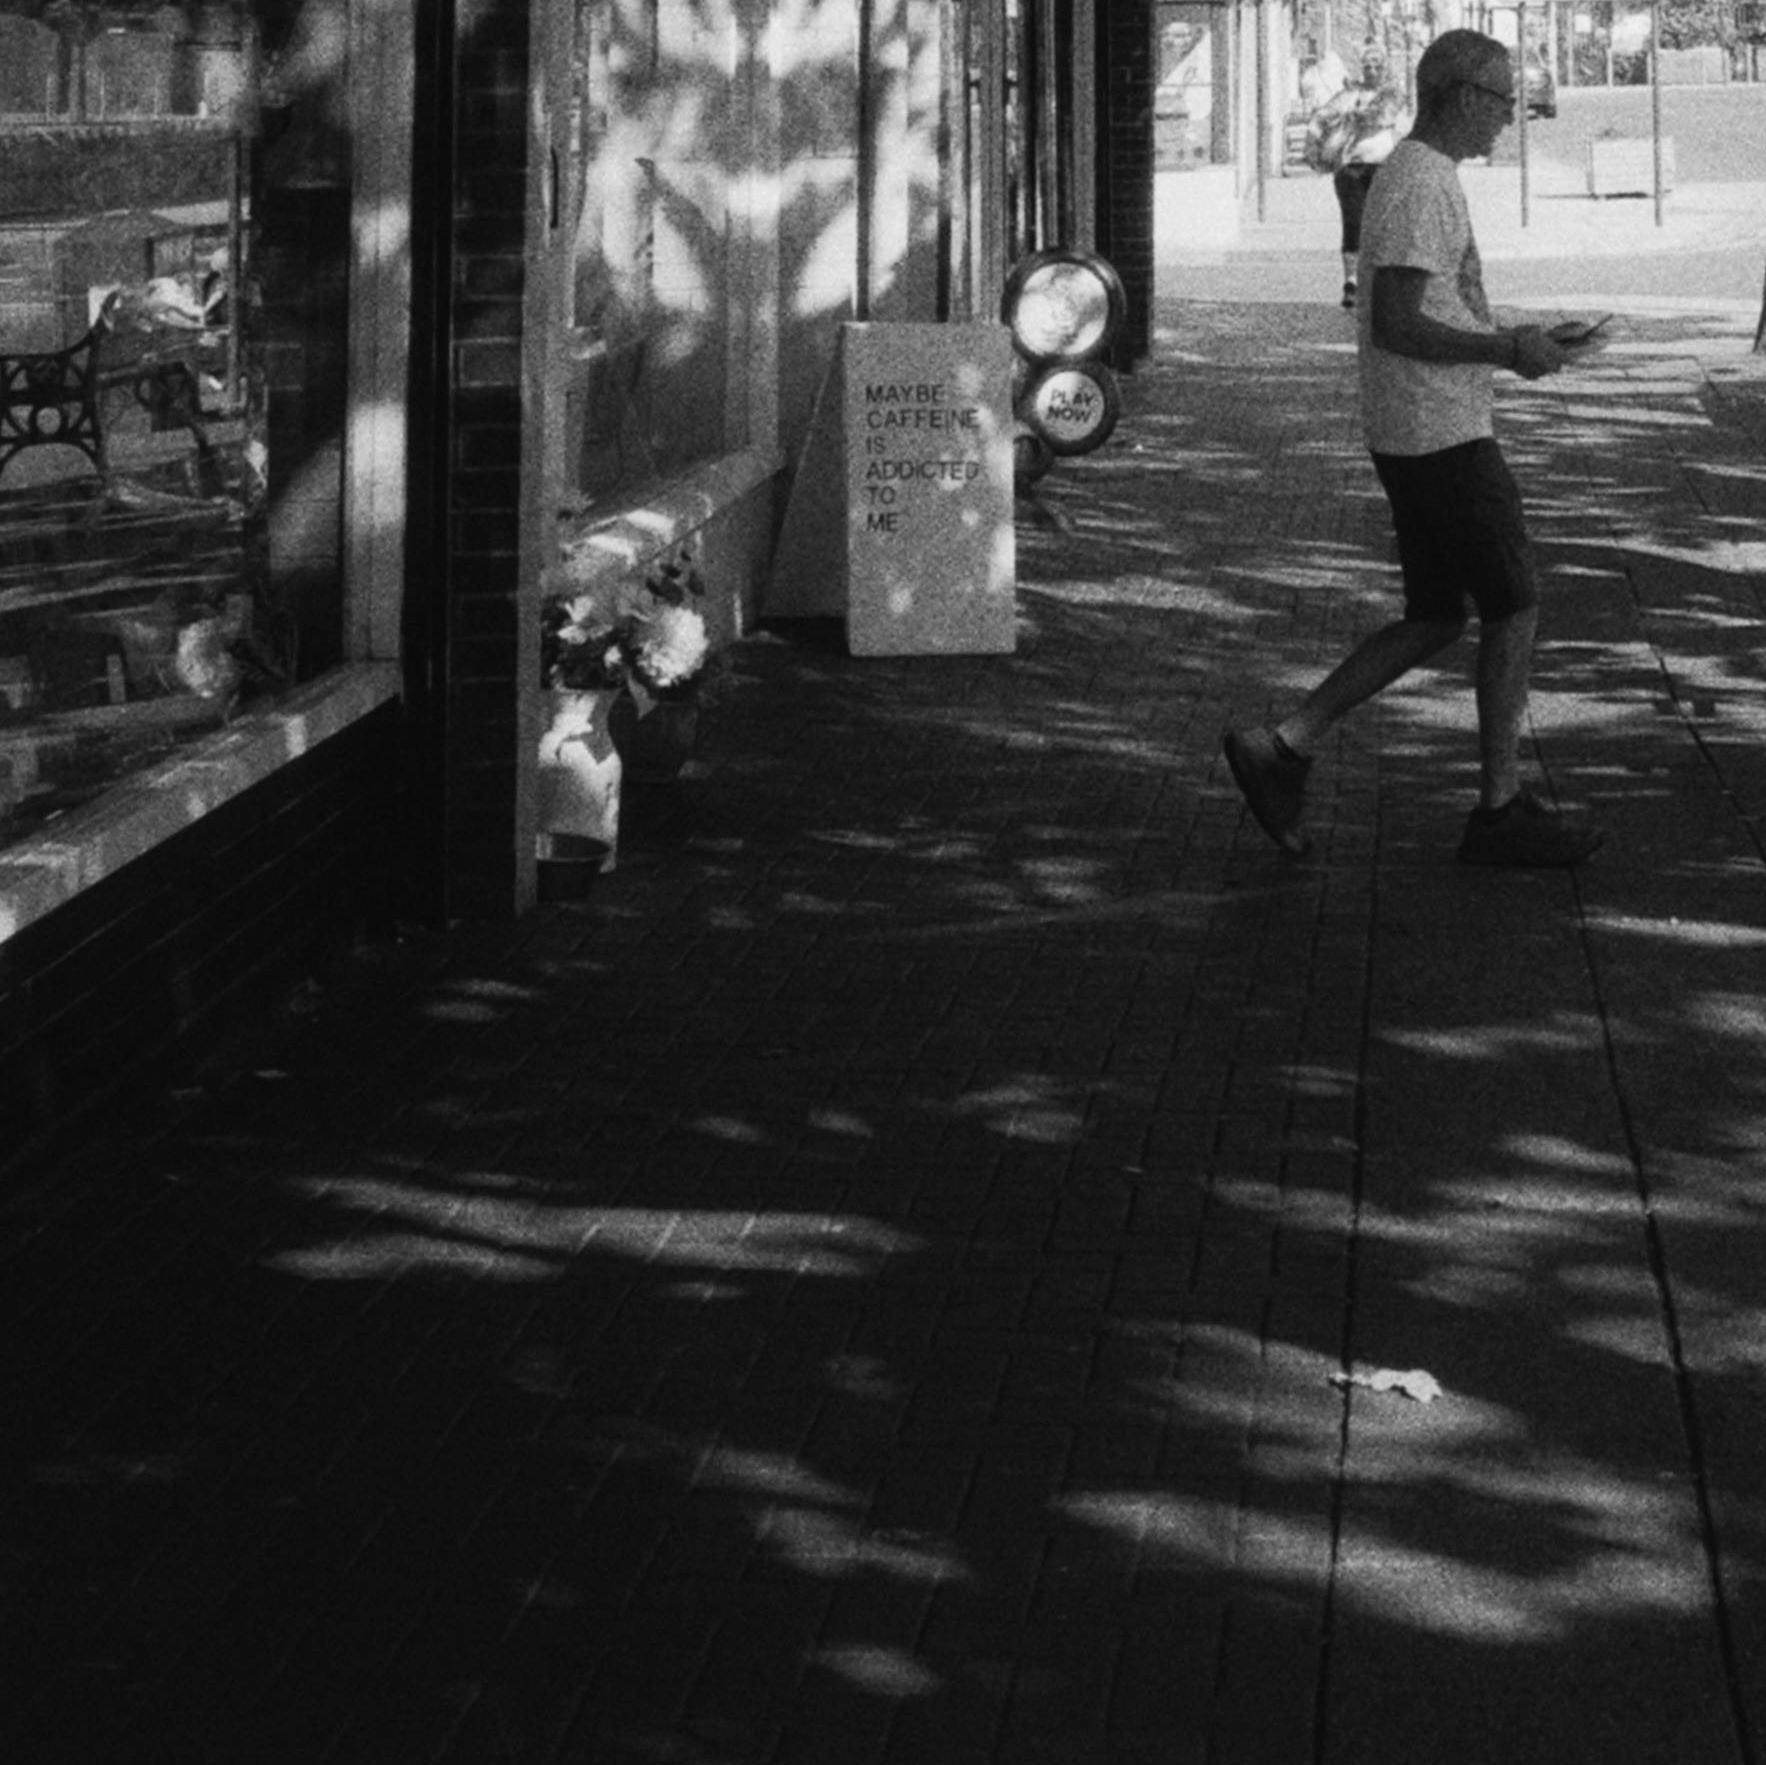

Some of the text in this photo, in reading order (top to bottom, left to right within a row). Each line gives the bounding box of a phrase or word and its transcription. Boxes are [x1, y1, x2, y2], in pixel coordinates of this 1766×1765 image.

[865, 384, 944, 405] MAYBE
[1050, 389, 1094, 407] PLAY
[866, 407, 980, 430] CAFFEINE
[1046, 404, 1093, 424] NOW
[866, 436, 886, 455] IS
[865, 460, 980, 481] ADDICTED
[865, 485, 897, 506] TO
[866, 511, 900, 533] ME
